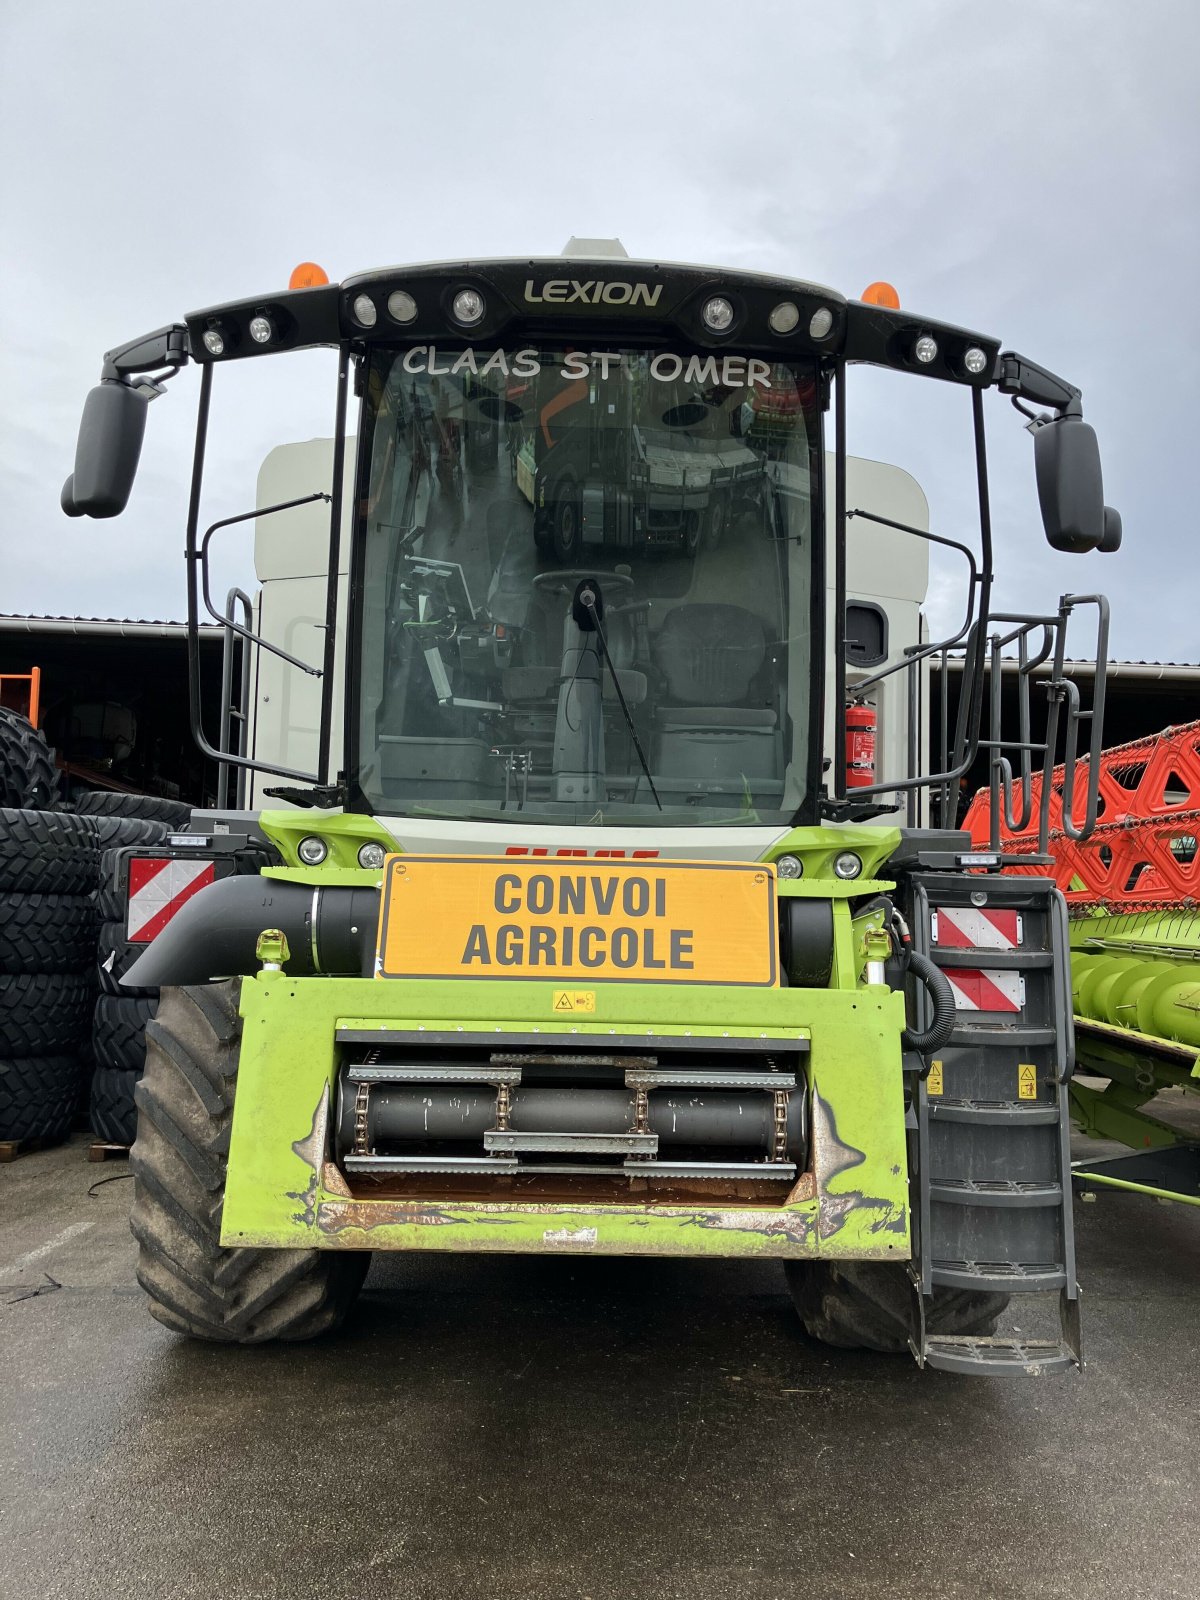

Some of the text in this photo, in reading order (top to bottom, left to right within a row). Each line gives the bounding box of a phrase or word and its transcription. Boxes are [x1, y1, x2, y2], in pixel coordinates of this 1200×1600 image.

[523, 279, 663, 307] LEXION
[402, 345, 773, 389] CLAAS ST OMER
[494, 873, 666, 917] CONVOI
[461, 924, 695, 970] AGRICOLE
